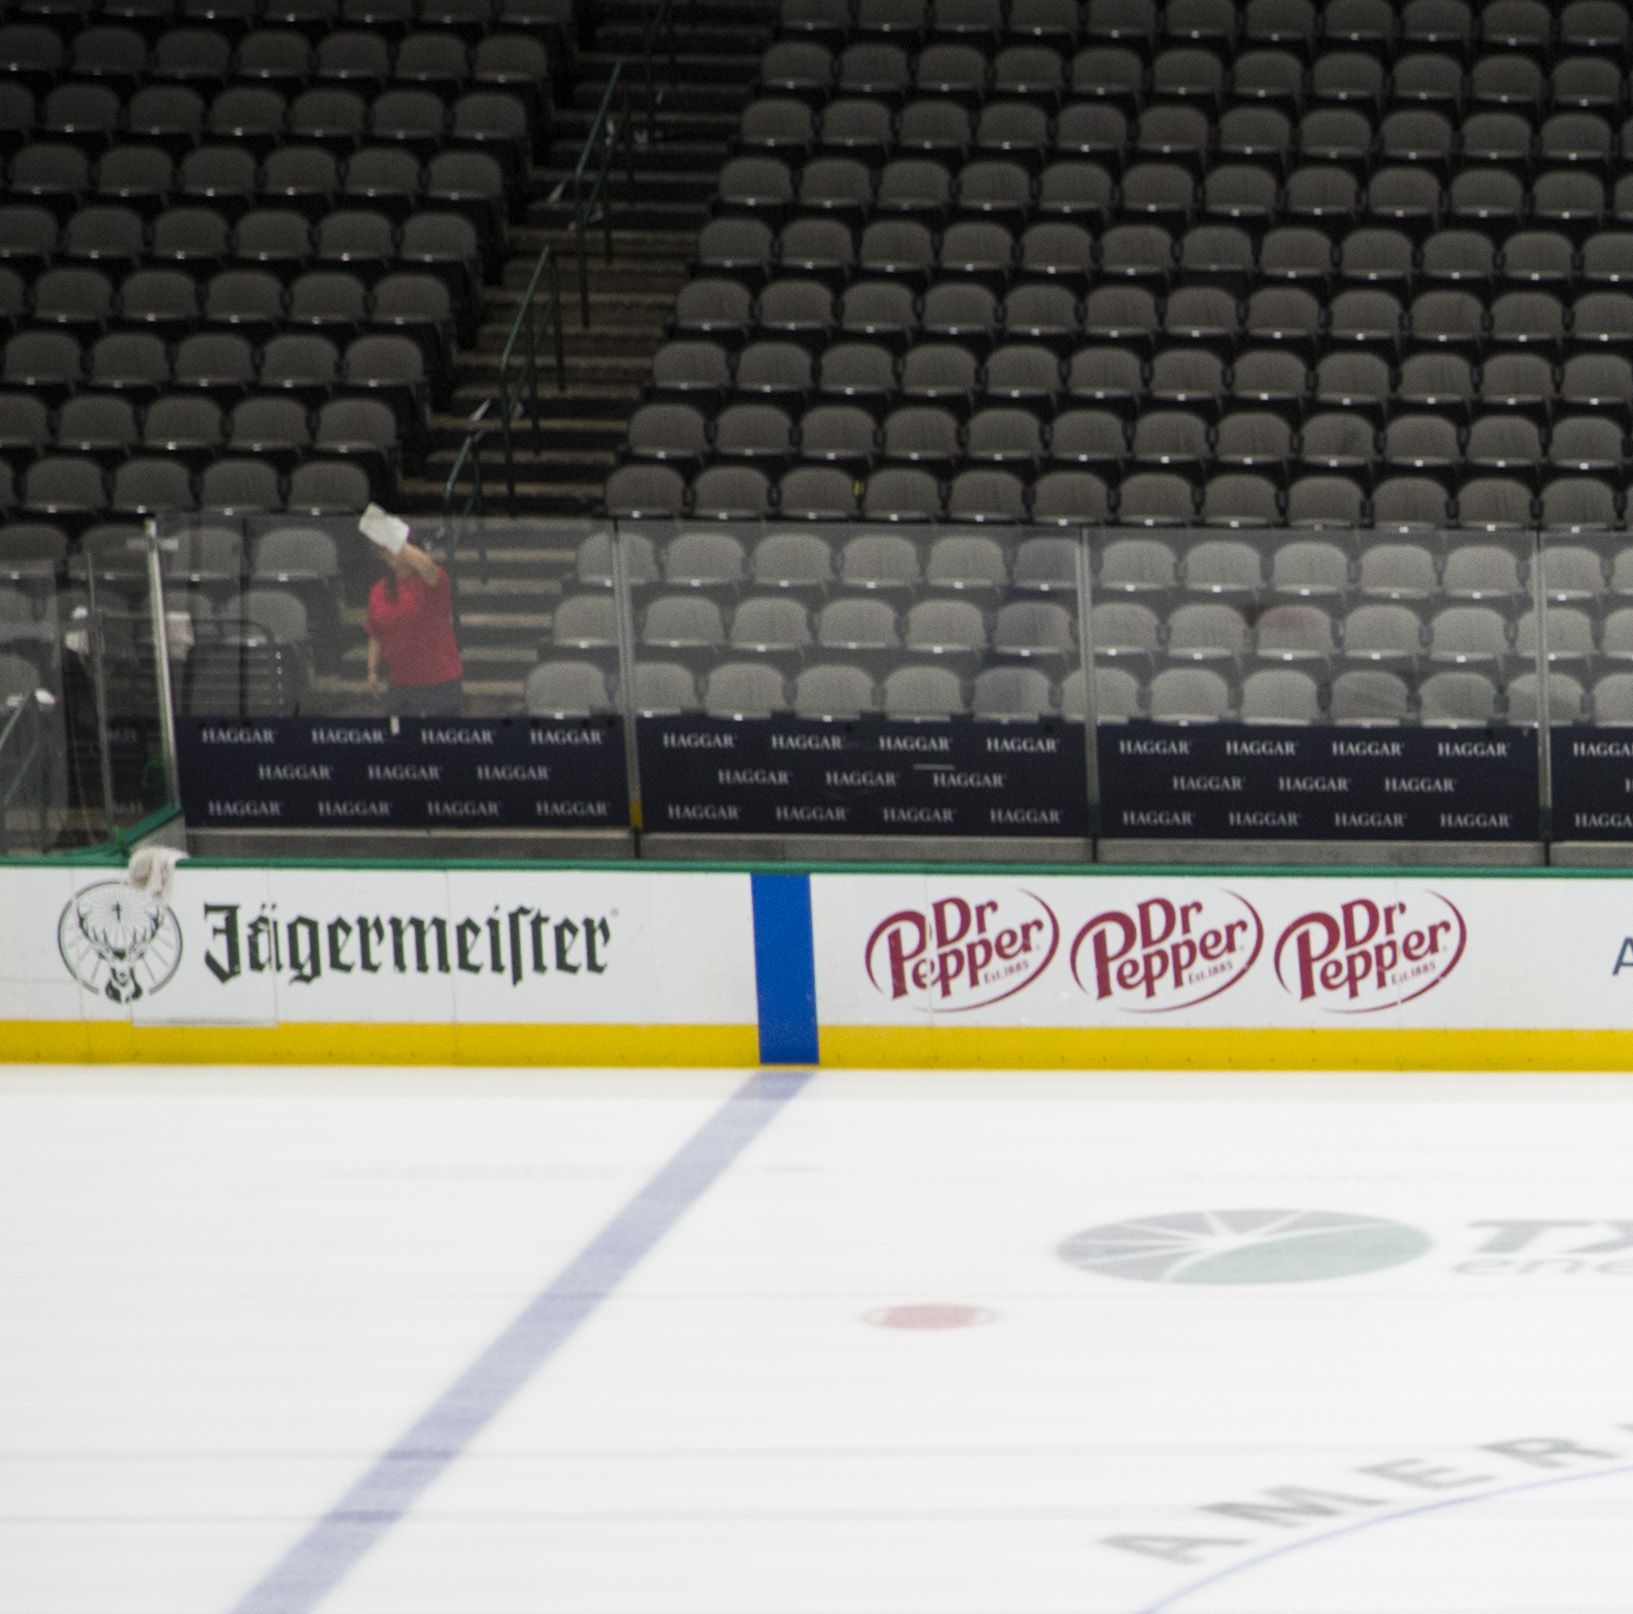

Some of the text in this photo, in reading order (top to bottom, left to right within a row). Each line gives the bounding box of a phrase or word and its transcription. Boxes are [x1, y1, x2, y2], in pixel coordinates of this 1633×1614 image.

[200, 727, 605, 745] HAGGAR HAGGAR HAGGAR HAGGAR
[662, 732, 1060, 753] HAGGAR HAGGAR HAGGAR HAGGAR
[1118, 740, 1511, 757] HAGGAR HAGGAR HAGGAR HAGGAR
[257, 764, 550, 780] HAGGAR HAGGAR HAGGAR
[716, 769, 1006, 788] HAGGAR HAGGAR HAGGAR
[1171, 776, 1457, 792] HAGGAR HAGGAR HAGGAR
[207, 801, 608, 815] HAGGAR HAGGAR HAGGAR HAGGAR
[667, 804, 1061, 823] HAGGAR HAGGAR HAGGAR HAGGAR
[1121, 811, 1512, 827] HAGGAR HAGGAR HAGGAR HAGGAR
[933, 897, 998, 947] Dr
[1137, 898, 1201, 948] Dr
[1341, 898, 1406, 949] Dr
[888, 910, 1043, 999] Pepper
[1094, 911, 1247, 1000] Pepper
[1298, 911, 1451, 1000] Pepper
